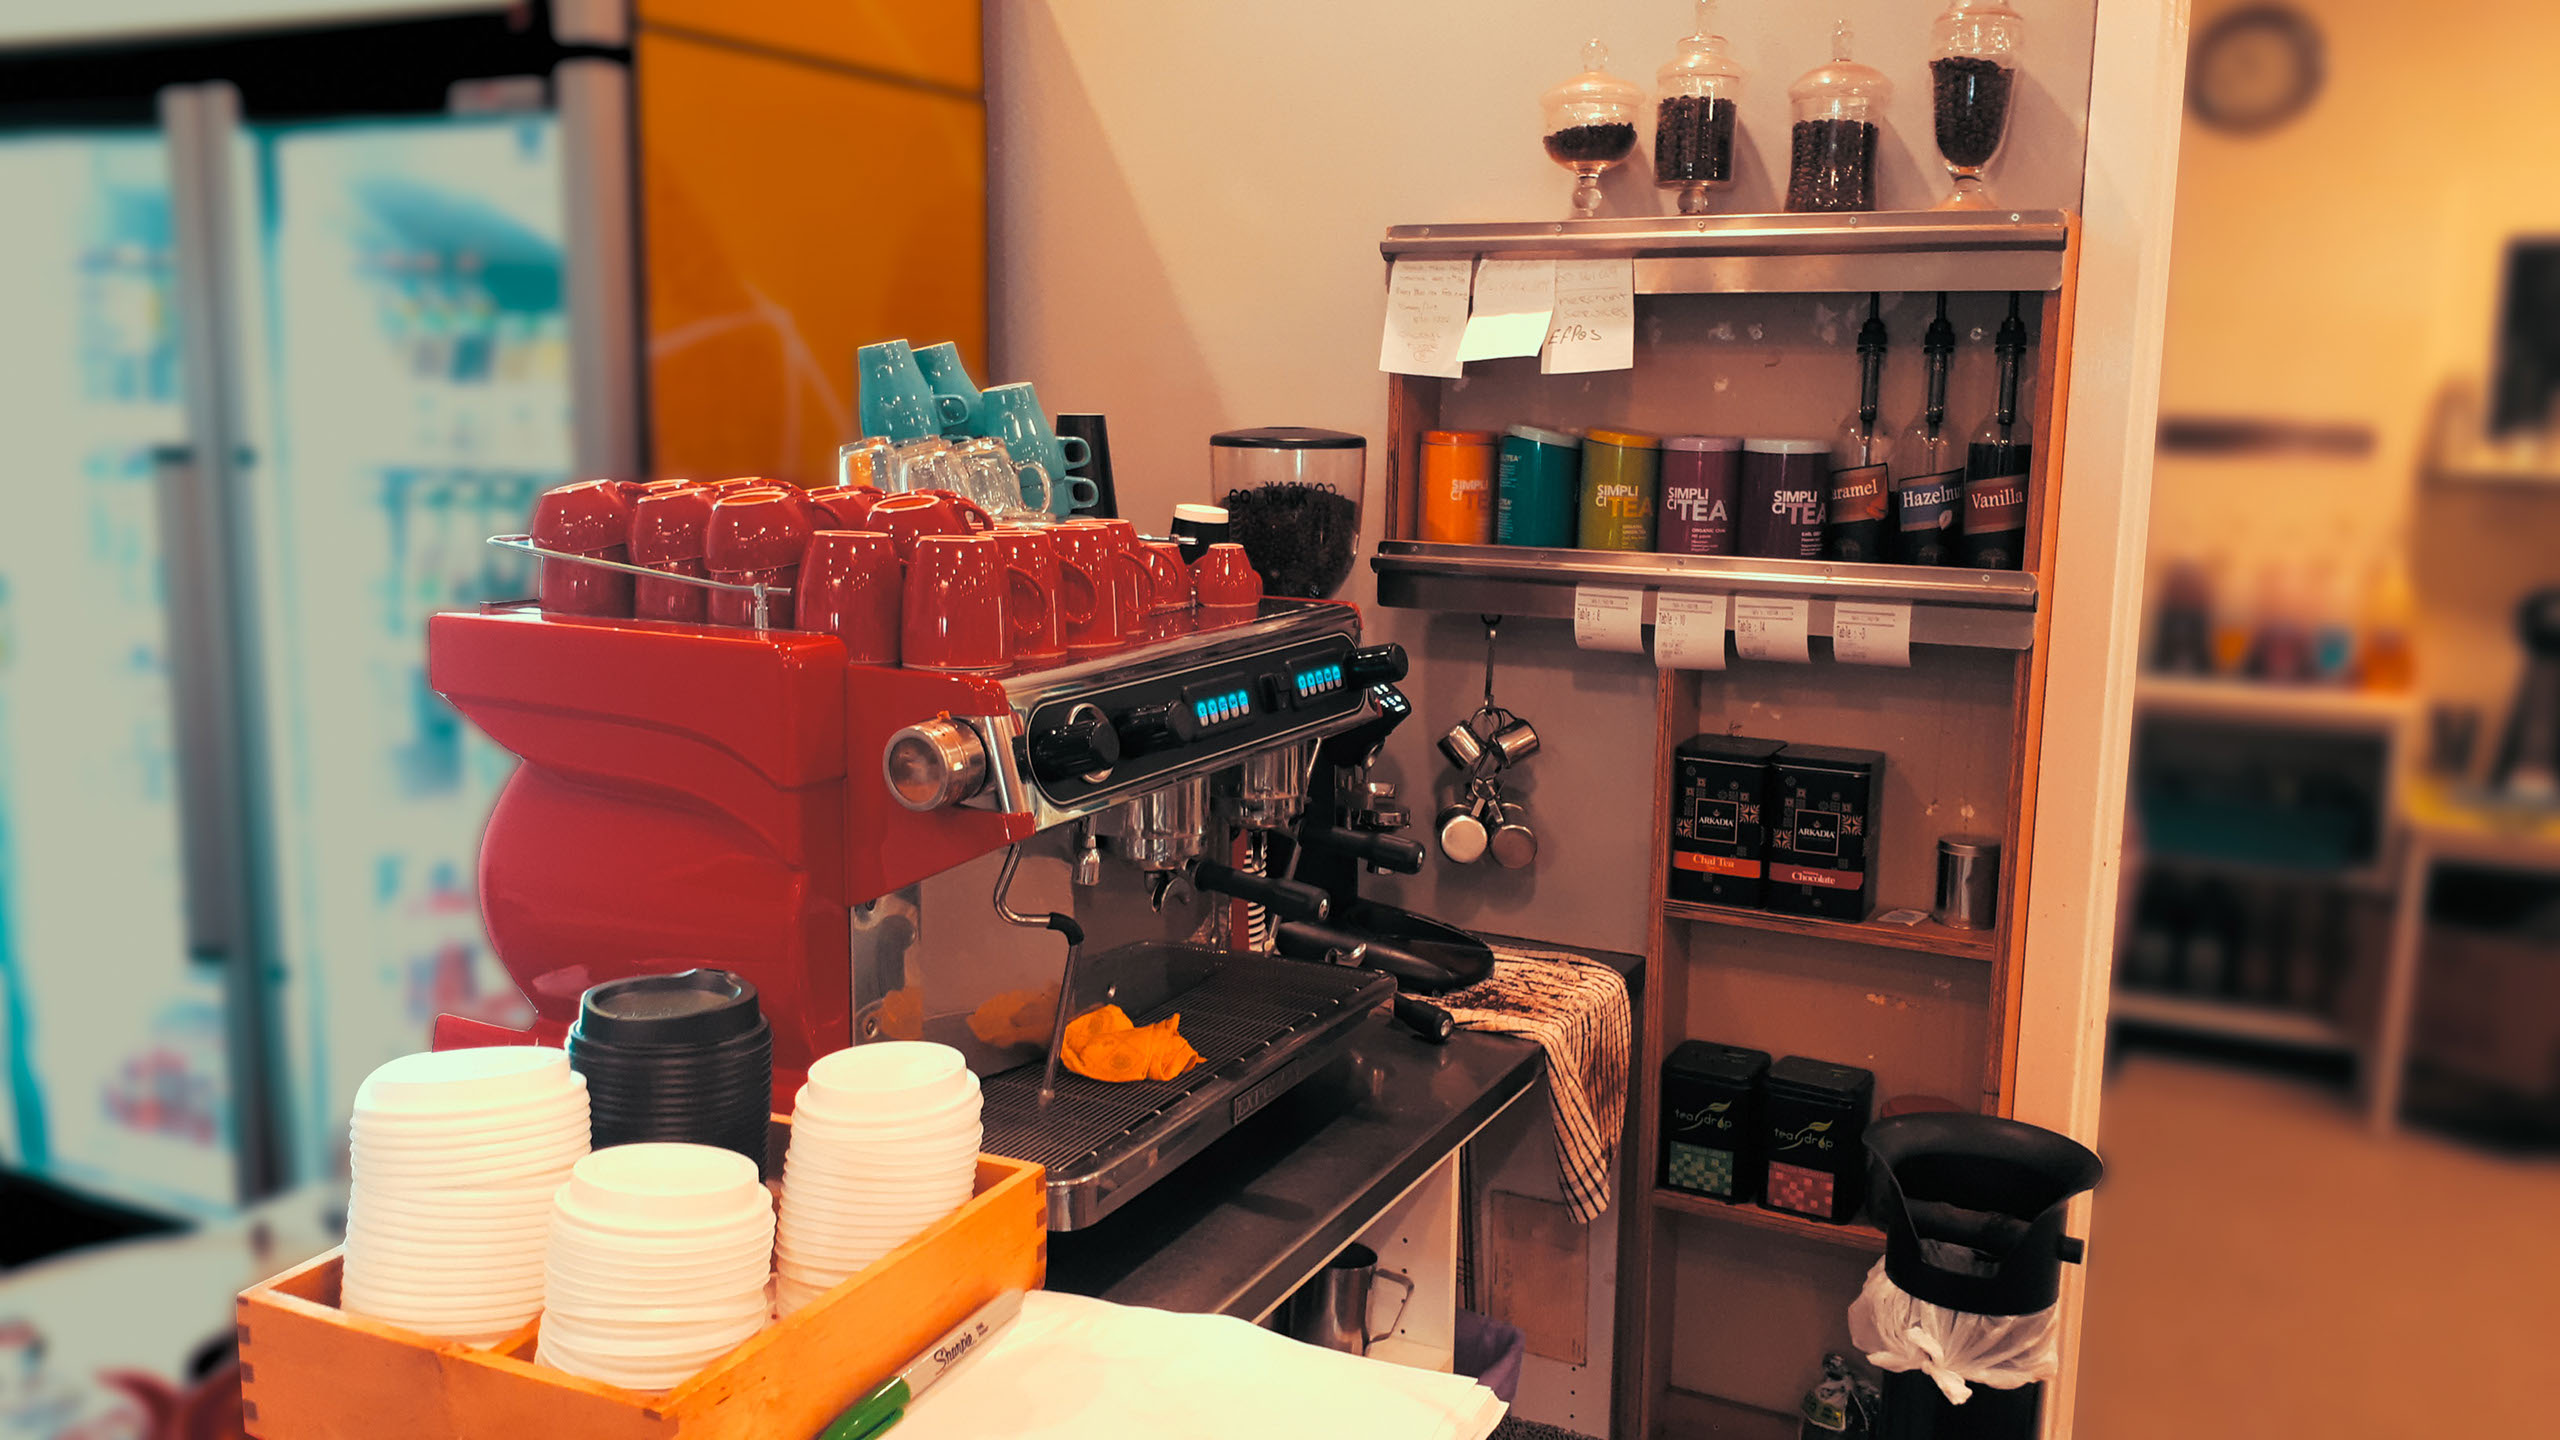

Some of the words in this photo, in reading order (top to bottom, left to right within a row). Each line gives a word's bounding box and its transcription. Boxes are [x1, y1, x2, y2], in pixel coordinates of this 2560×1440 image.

[1596, 483, 1639, 497] SIMPLI
[1667, 486, 1709, 500] SIMPLI
[1773, 489, 1818, 503] SIMPLI
[1971, 486, 2024, 511] Vanilla
[1698, 815, 1735, 829] ARKADIA
[1798, 827, 1836, 840] ARKADIA
[1717, 857, 1736, 869] Tea
[1791, 871, 1837, 885] Chocolate
[933, 1331, 976, 1376] Sharpie
